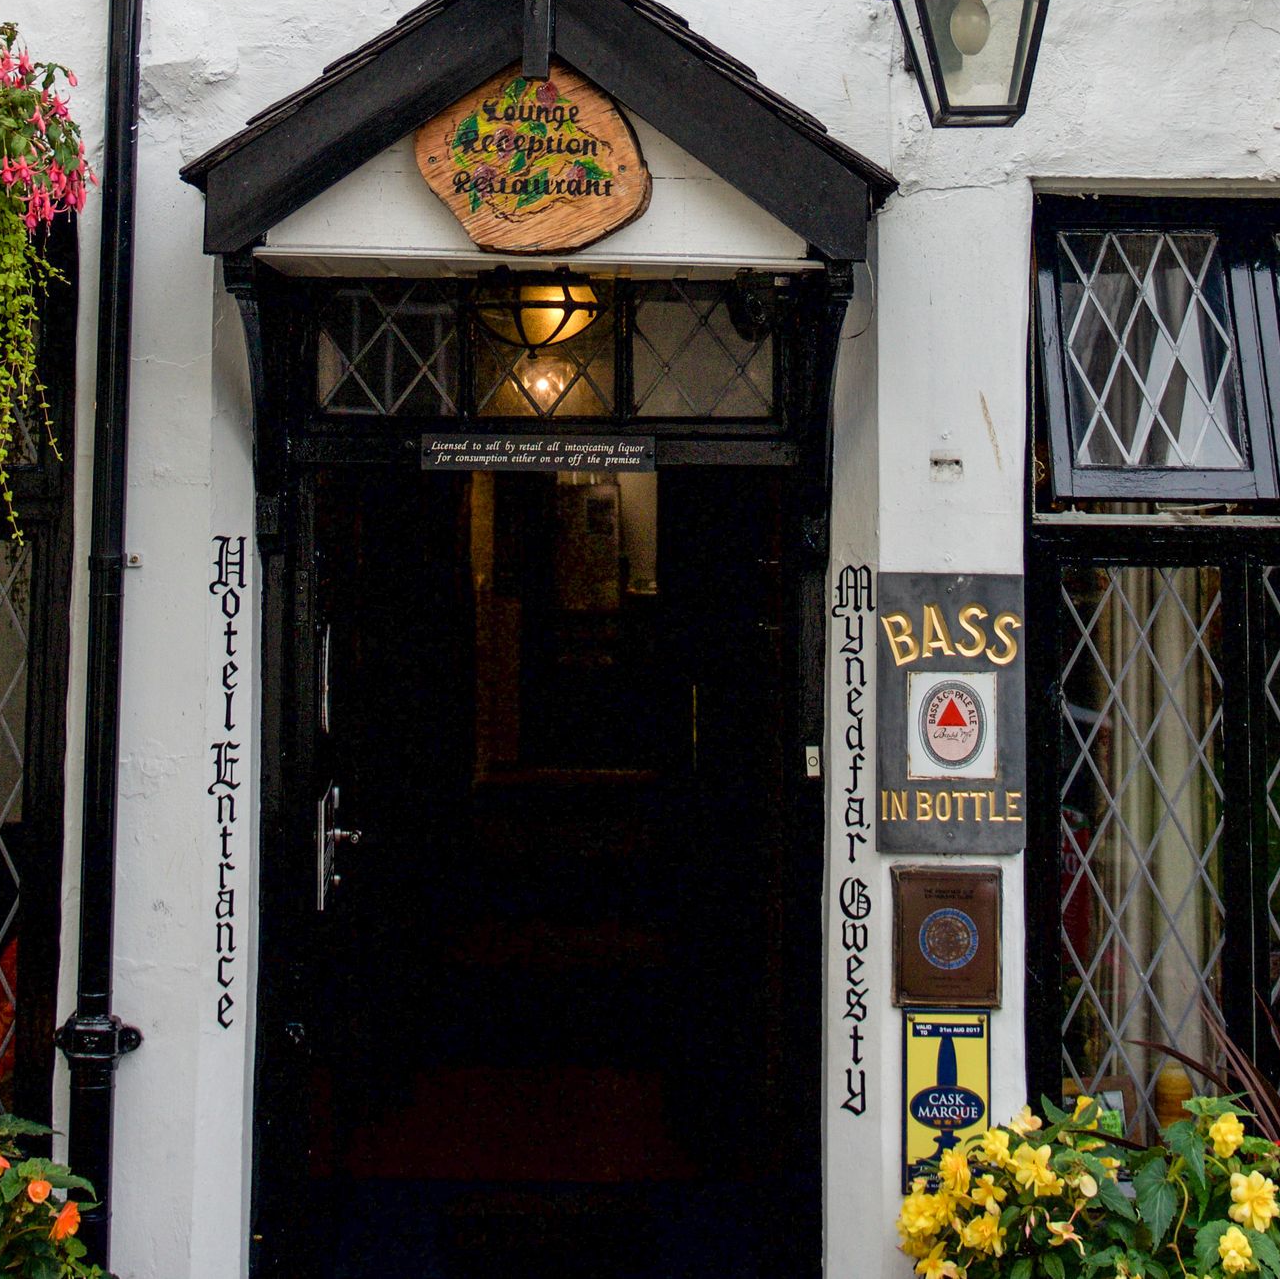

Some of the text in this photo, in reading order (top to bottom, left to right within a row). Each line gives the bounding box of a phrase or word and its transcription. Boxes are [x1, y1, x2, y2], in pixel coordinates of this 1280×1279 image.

[482, 99, 580, 131] Lounge
[460, 130, 599, 158] Reception
[452, 171, 614, 197] Restaurant
[431, 440, 644, 455] Licensed to sell by retail all intoxicating liquor
[435, 453, 640, 466] for consumption either on or off the premises
[881, 602, 1022, 667] BASS
[928, 702, 940, 725] BASS
[954, 690, 972, 708] PALE
[968, 709, 978, 726] ALE
[207, 535, 247, 1030] Hotel Entrance
[881, 789, 1022, 822] IN BOTTLE
[839, 876, 872, 1117] Gwesty
[917, 1106, 978, 1120] MARQUE
[928, 1093, 966, 1106] CASK
